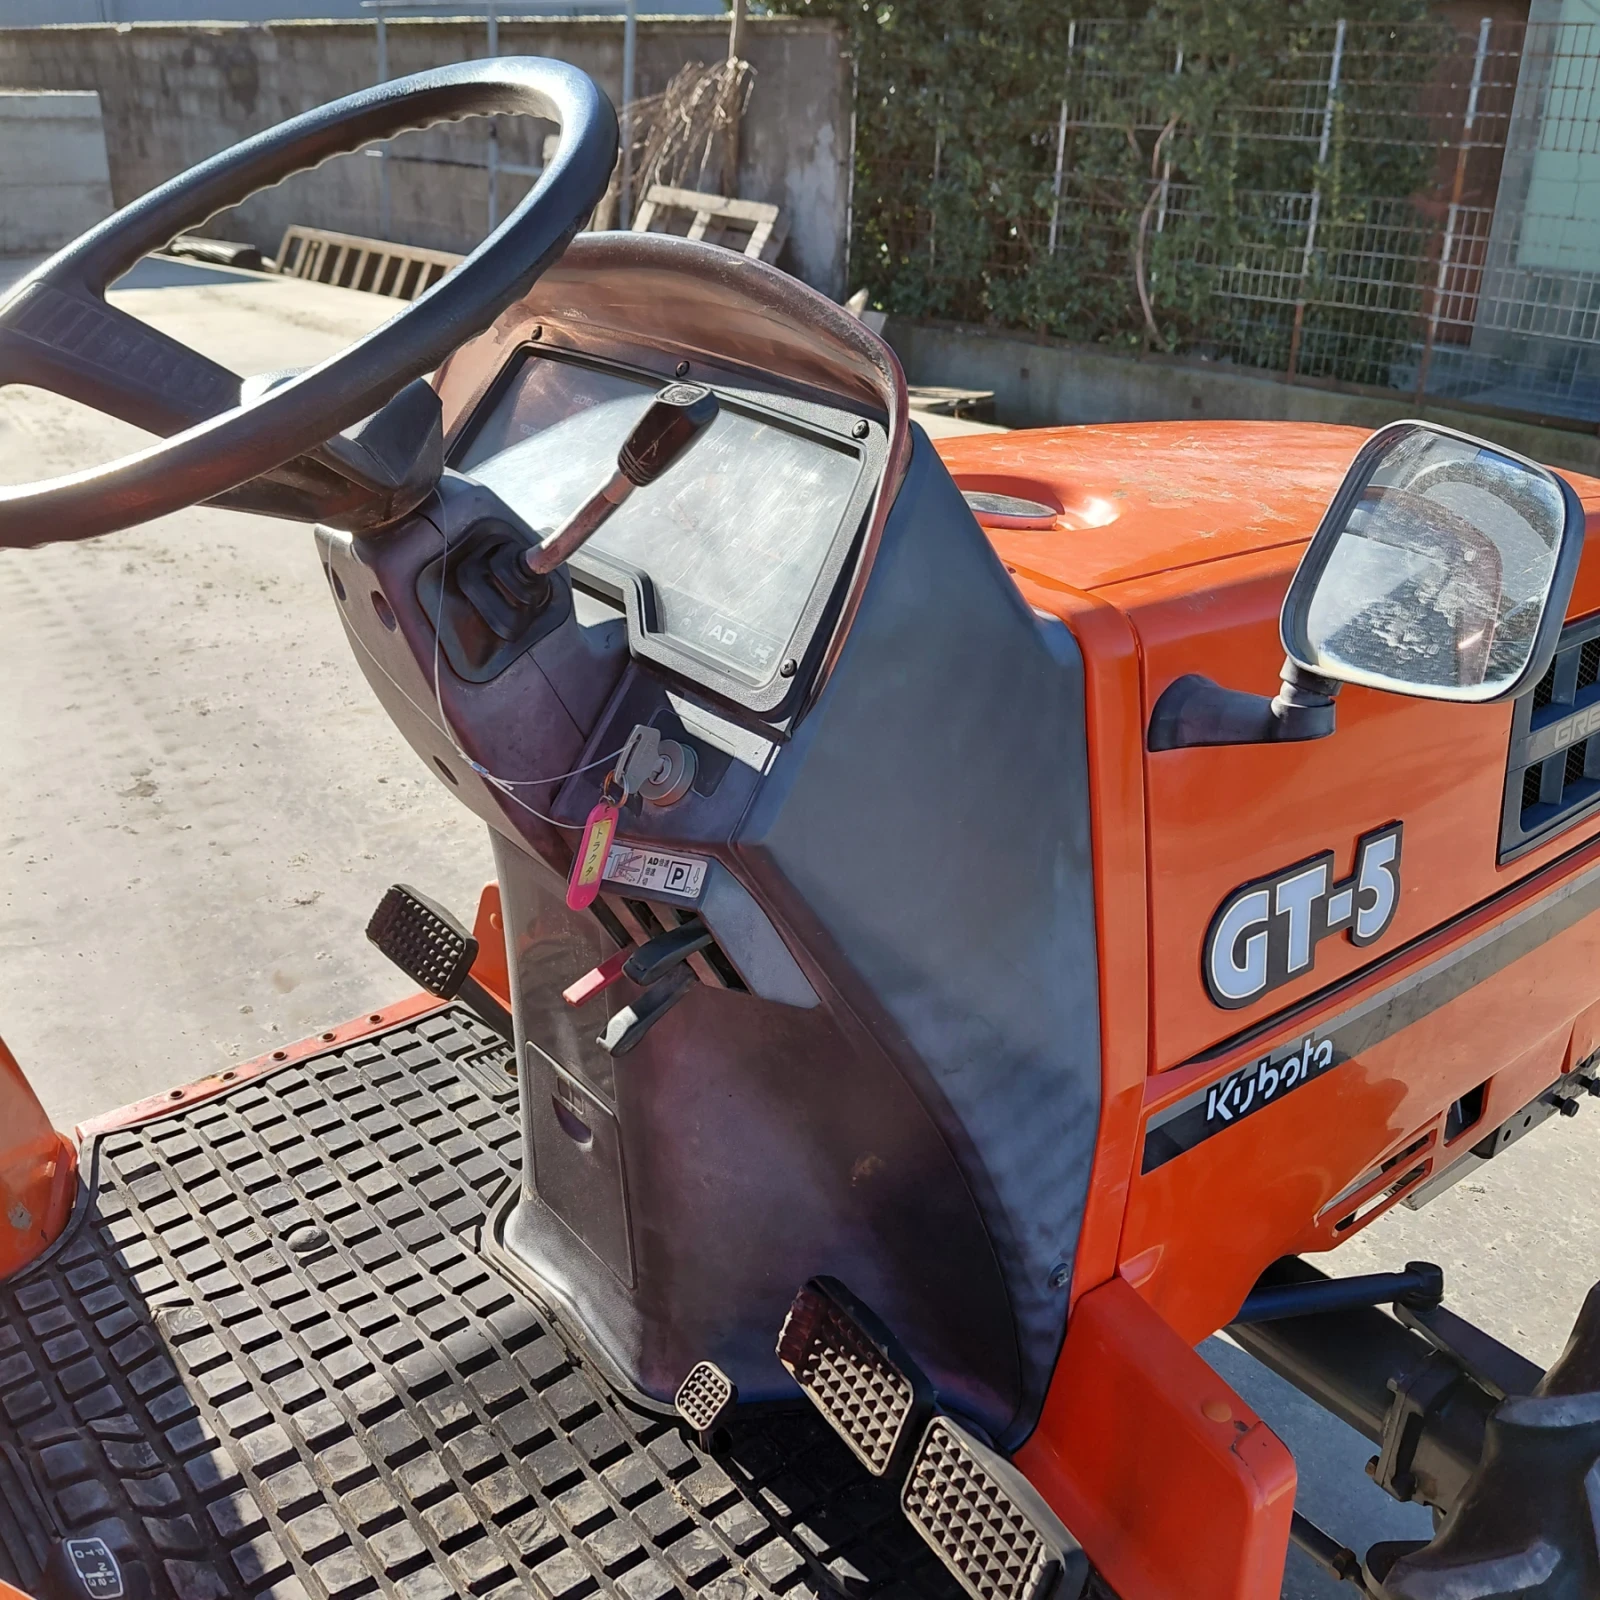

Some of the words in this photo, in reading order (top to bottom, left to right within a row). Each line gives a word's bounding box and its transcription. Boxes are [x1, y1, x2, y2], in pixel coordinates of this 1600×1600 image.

[708, 624, 738, 646] AD
[671, 867, 685, 885] P
[1210, 833, 1398, 1000] GT-5
[1206, 1037, 1334, 1121] Kubota
